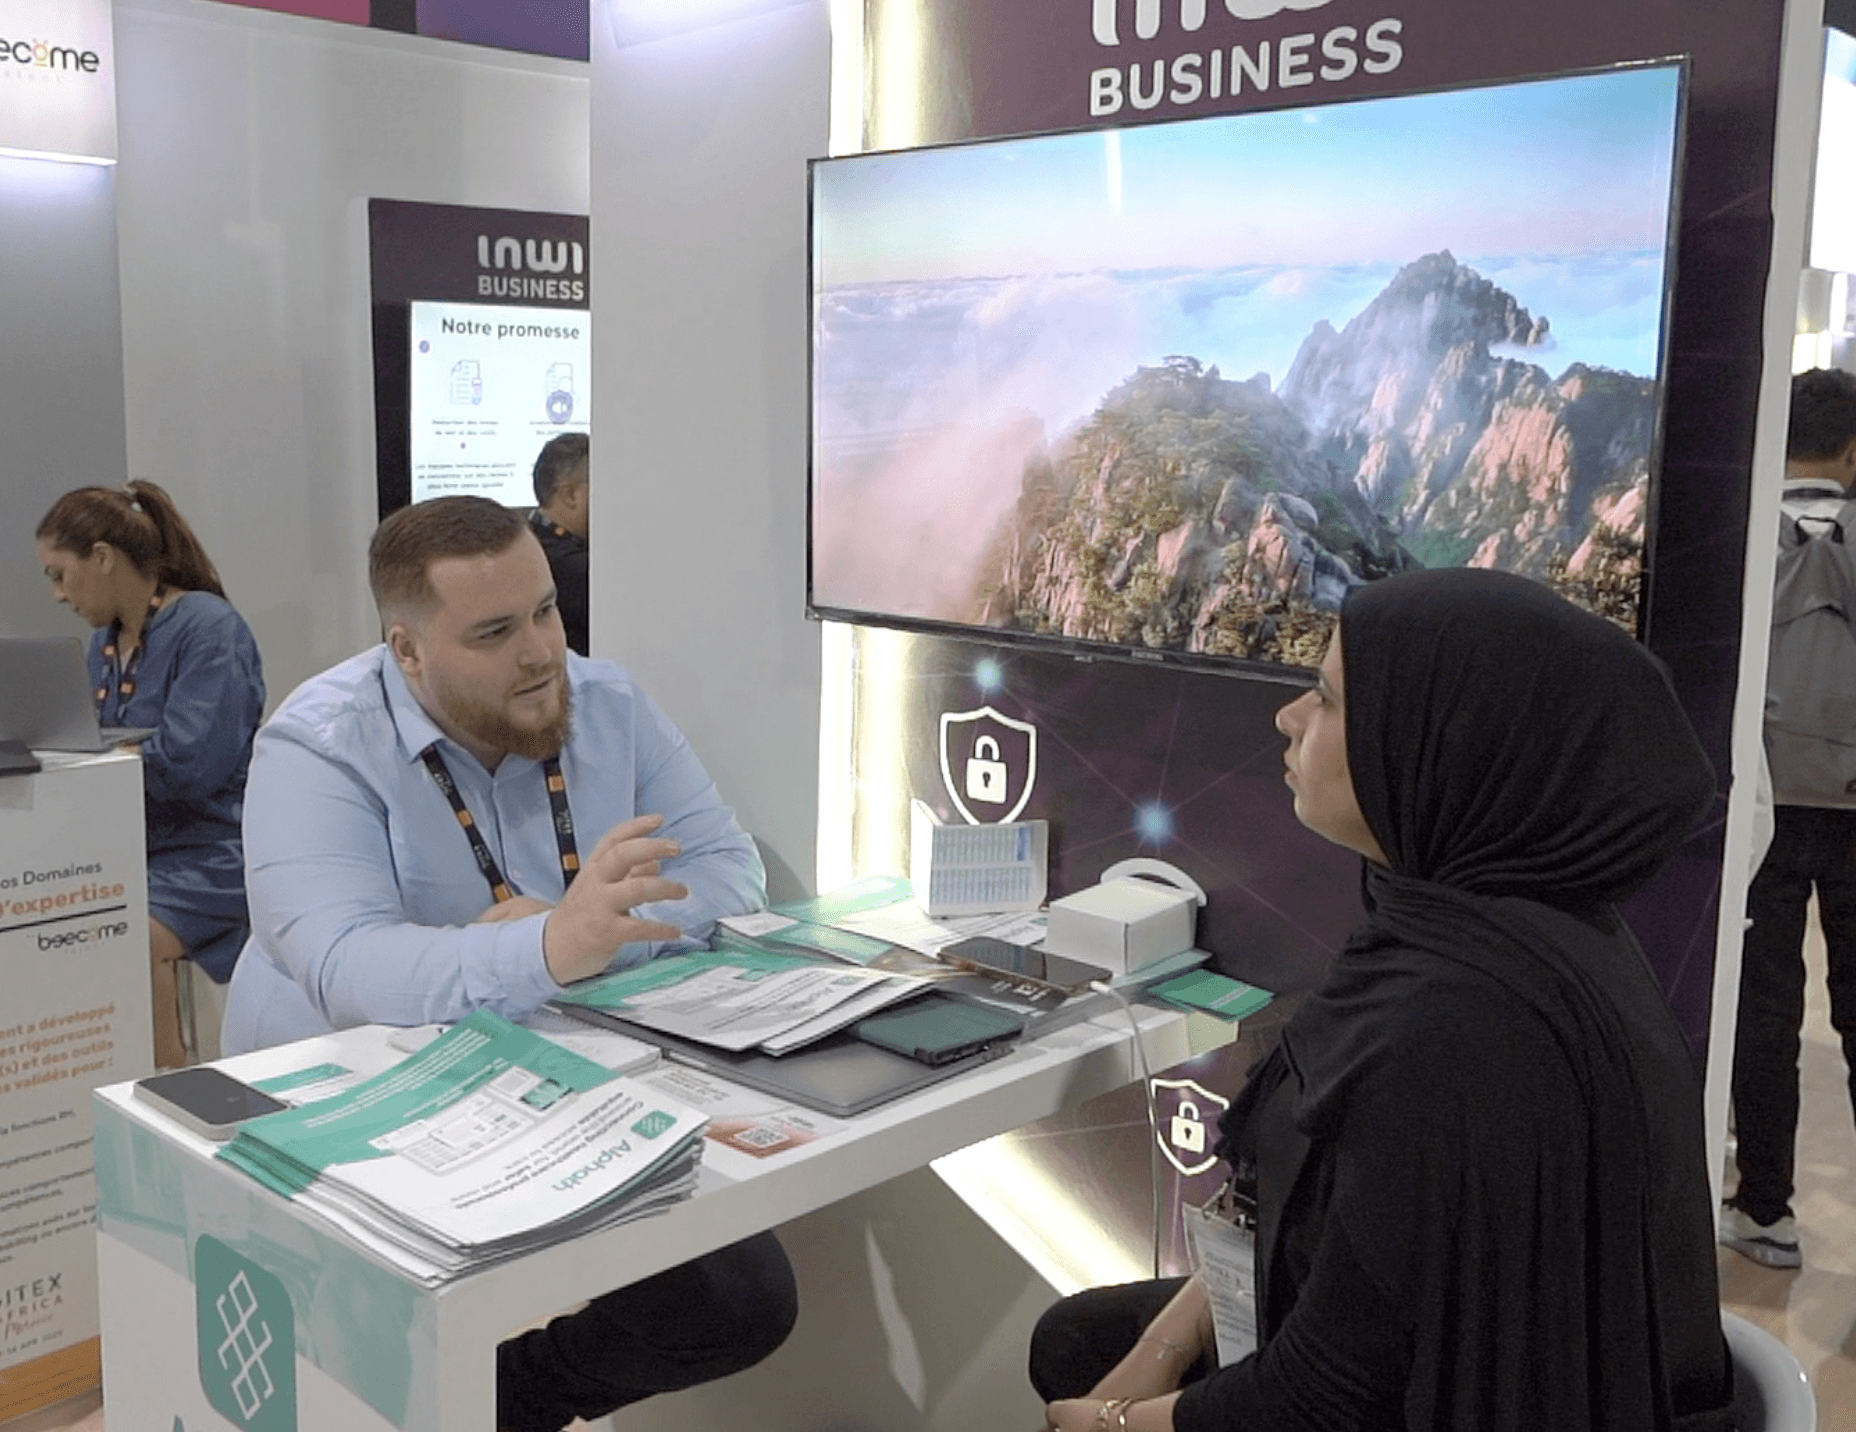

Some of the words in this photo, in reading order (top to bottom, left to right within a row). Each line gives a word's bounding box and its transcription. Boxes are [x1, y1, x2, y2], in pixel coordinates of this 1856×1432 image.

[1090, 18, 1403, 117] BUSINESS
[478, 275, 584, 300] BUSINESS
[442, 317, 492, 335] Notre
[498, 323, 580, 339] promesse
[23, 862, 102, 885] Domaines
[0, 1272, 62, 1308] ITEX
[0, 1294, 63, 1323] FRICA
